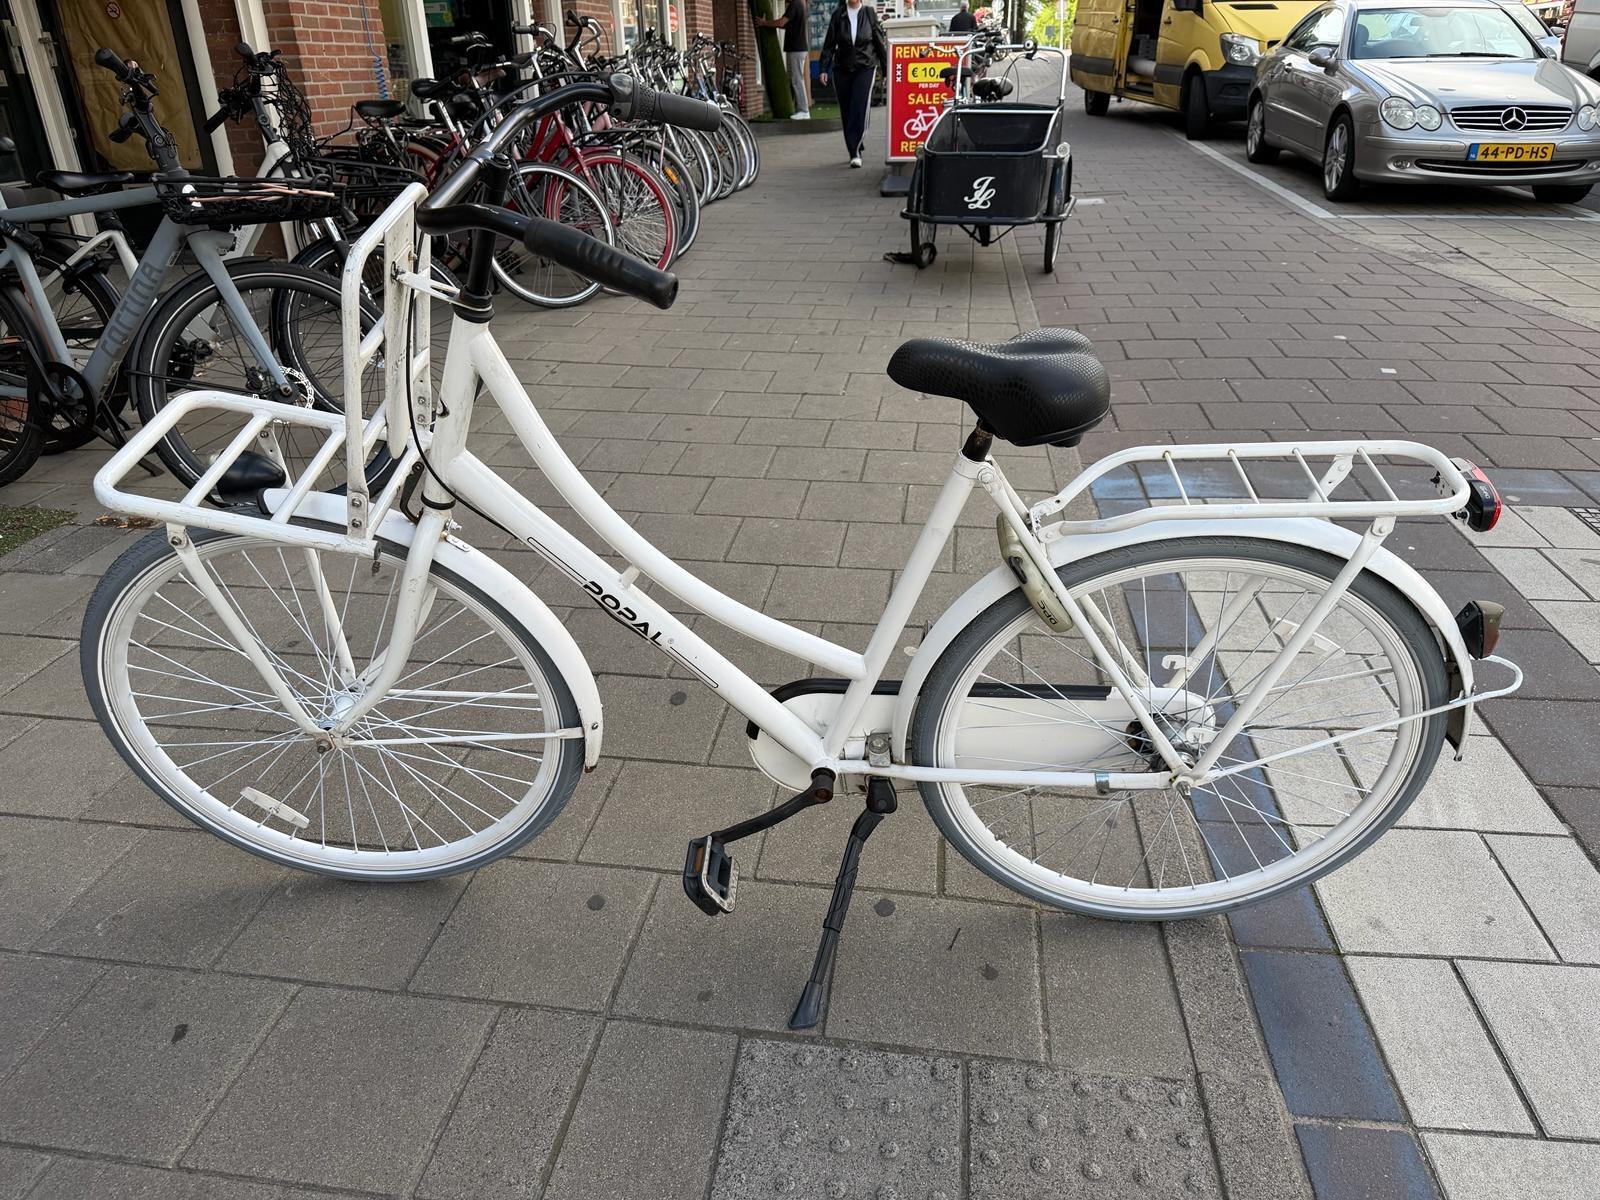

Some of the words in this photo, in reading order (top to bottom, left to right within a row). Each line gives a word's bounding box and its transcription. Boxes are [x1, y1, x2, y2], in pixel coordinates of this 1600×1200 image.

[908, 93, 948, 105] SALES
[1480, 146, 1549, 159] 44-PD-HS
[583, 580, 663, 647] POPAL
